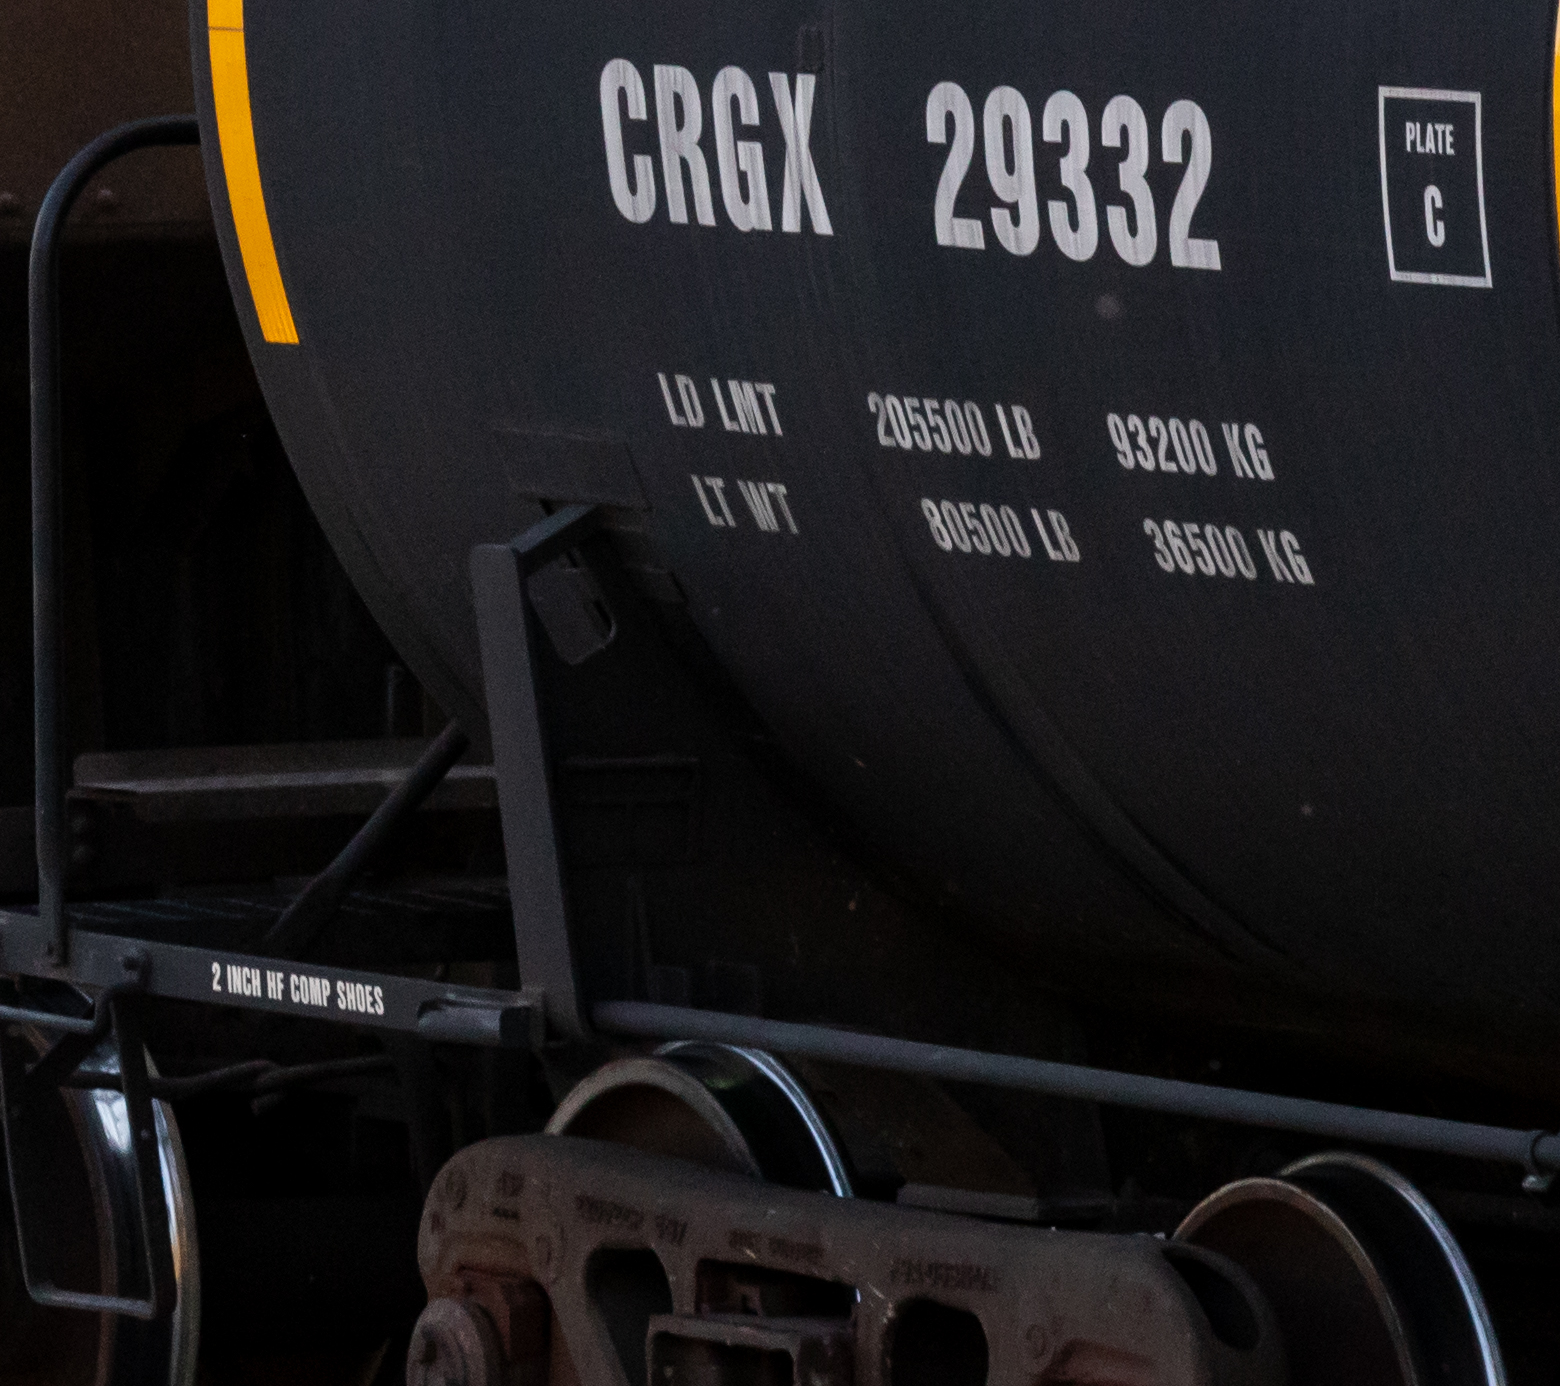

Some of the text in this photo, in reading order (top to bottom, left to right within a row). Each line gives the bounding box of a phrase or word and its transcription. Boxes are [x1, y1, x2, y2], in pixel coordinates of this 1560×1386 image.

[599, 58, 1221, 270] CRGX 29332
[1405, 120, 1455, 157] PLATE
[1423, 184, 1445, 248] C
[657, 372, 1275, 481] LD LMT 205500 LB 93200 KG
[690, 473, 1315, 585] LT WT 80500 LB 36500 KG
[211, 962, 385, 1016] 2 INCH HF COMP SHOES
